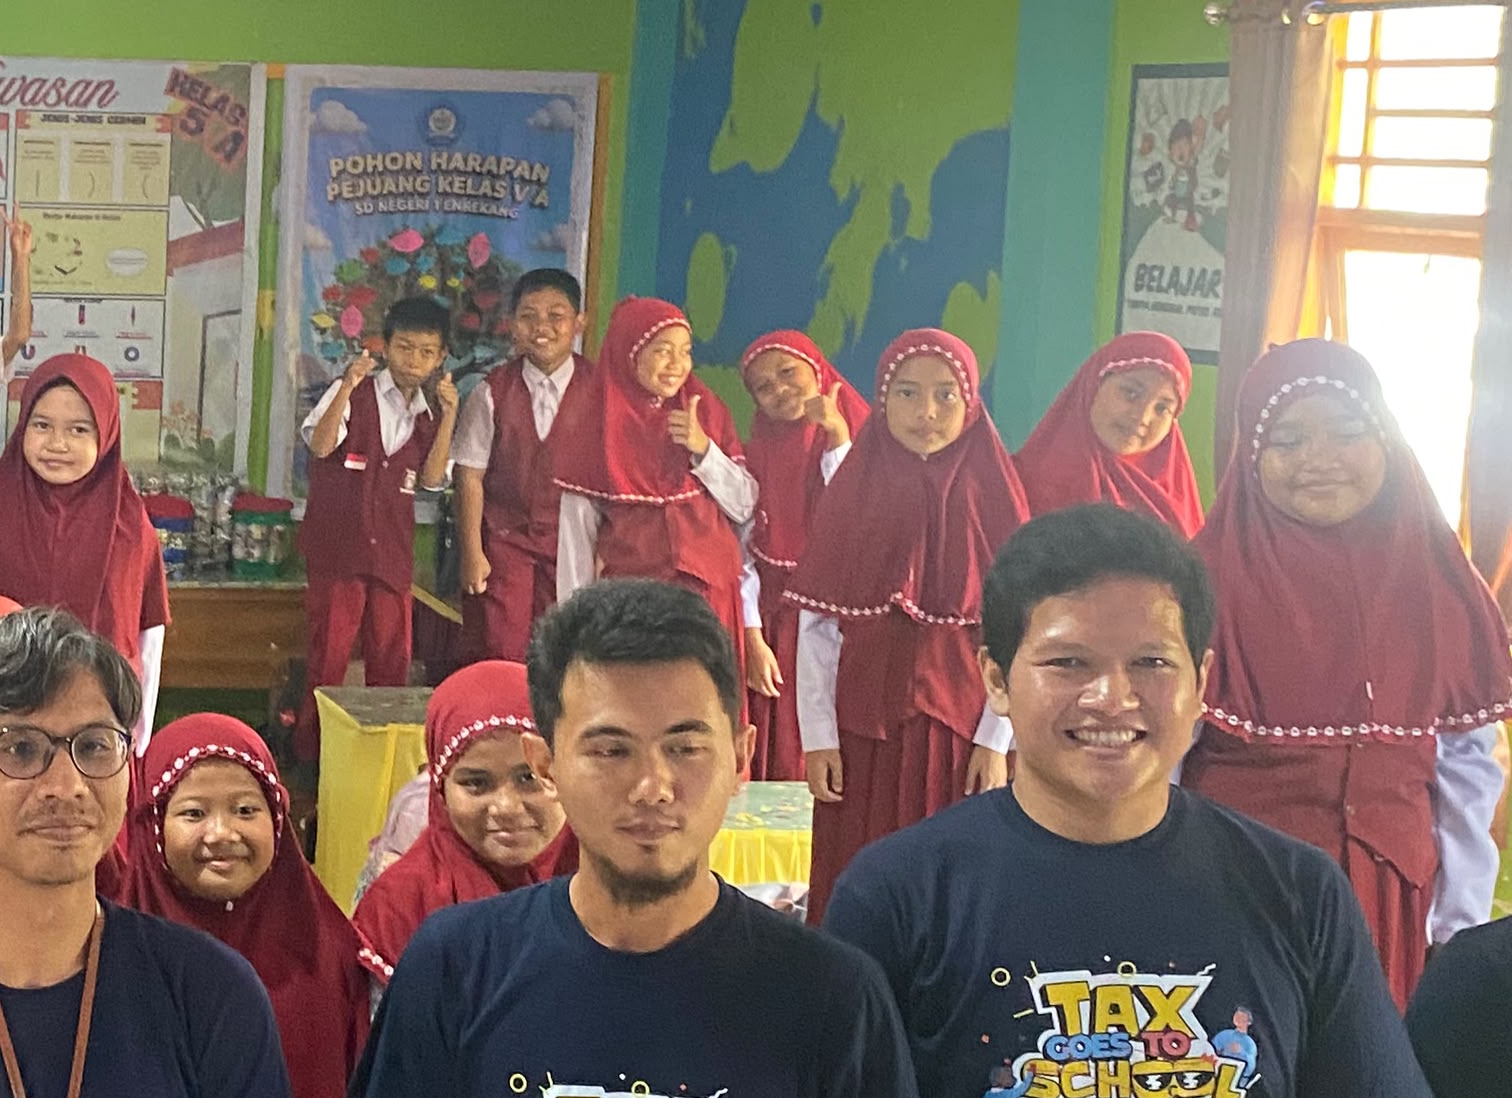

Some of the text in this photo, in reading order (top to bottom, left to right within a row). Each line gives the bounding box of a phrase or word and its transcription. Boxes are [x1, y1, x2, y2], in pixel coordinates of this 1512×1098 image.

[329, 152, 551, 183] POHON HARAPAN
[326, 176, 550, 207] PEJUANG KELAS V A
[355, 202, 374, 215] SD
[377, 199, 429, 212] NEGERI
[443, 199, 520, 218] ENREKANG
[1134, 263, 1221, 298] BELAJAR
[1044, 981, 1198, 1039] TAX
[1043, 1030, 1193, 1062] GOES TO
